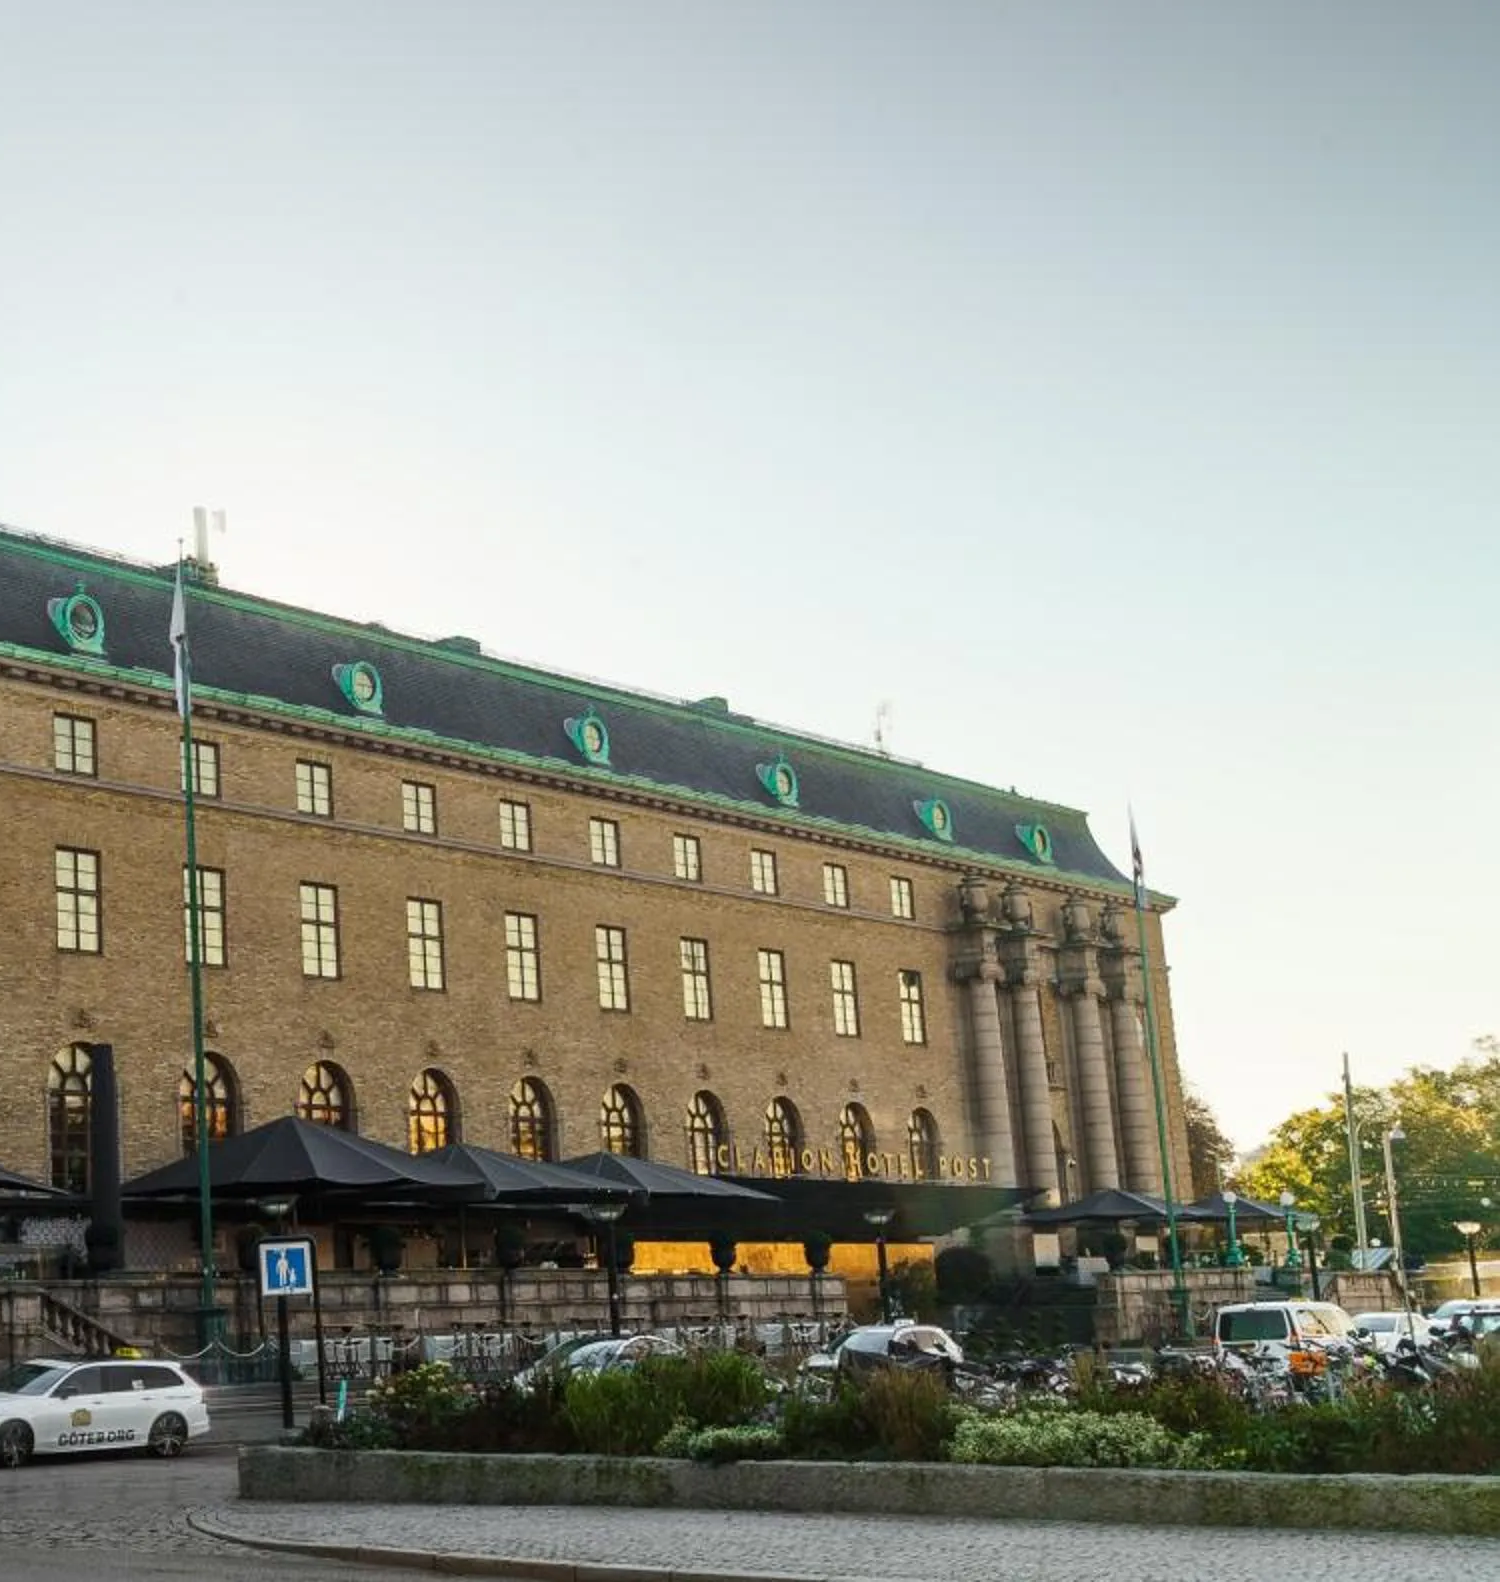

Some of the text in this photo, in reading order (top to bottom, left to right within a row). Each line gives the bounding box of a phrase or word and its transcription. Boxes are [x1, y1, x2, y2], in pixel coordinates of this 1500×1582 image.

[718, 1144, 991, 1180] CLARION HOTEL POST
